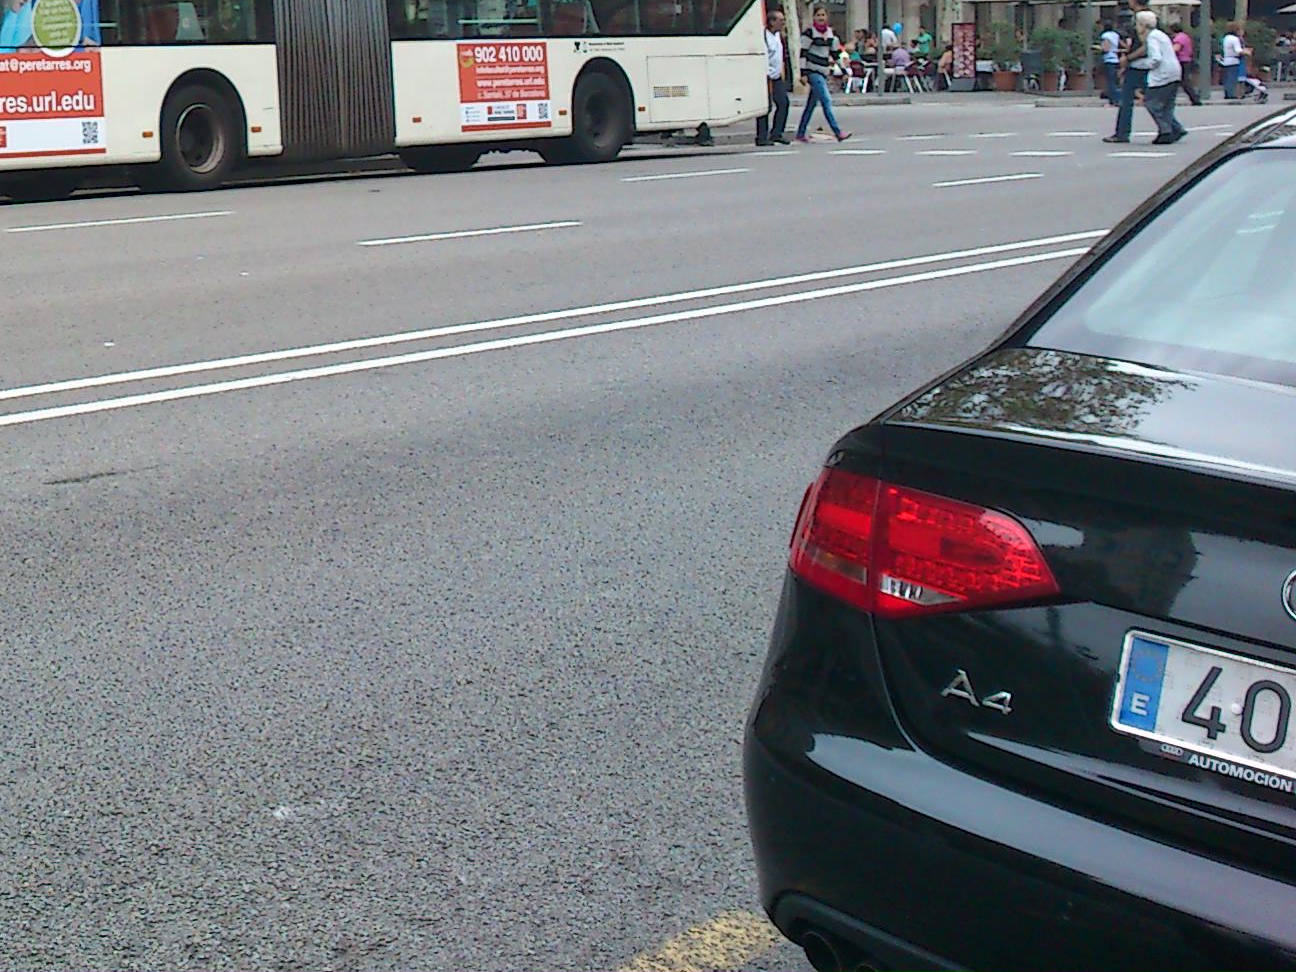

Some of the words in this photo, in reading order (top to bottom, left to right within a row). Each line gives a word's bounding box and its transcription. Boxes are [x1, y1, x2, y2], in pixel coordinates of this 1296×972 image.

[474, 46, 497, 63] 902
[497, 45, 520, 62] 410
[521, 45, 544, 62] 000
[940, 667, 1014, 716] A4
[1130, 692, 1151, 717] E
[1181, 665, 1292, 754] 40
[1188, 753, 1293, 793] AUTOMOCIÓN
